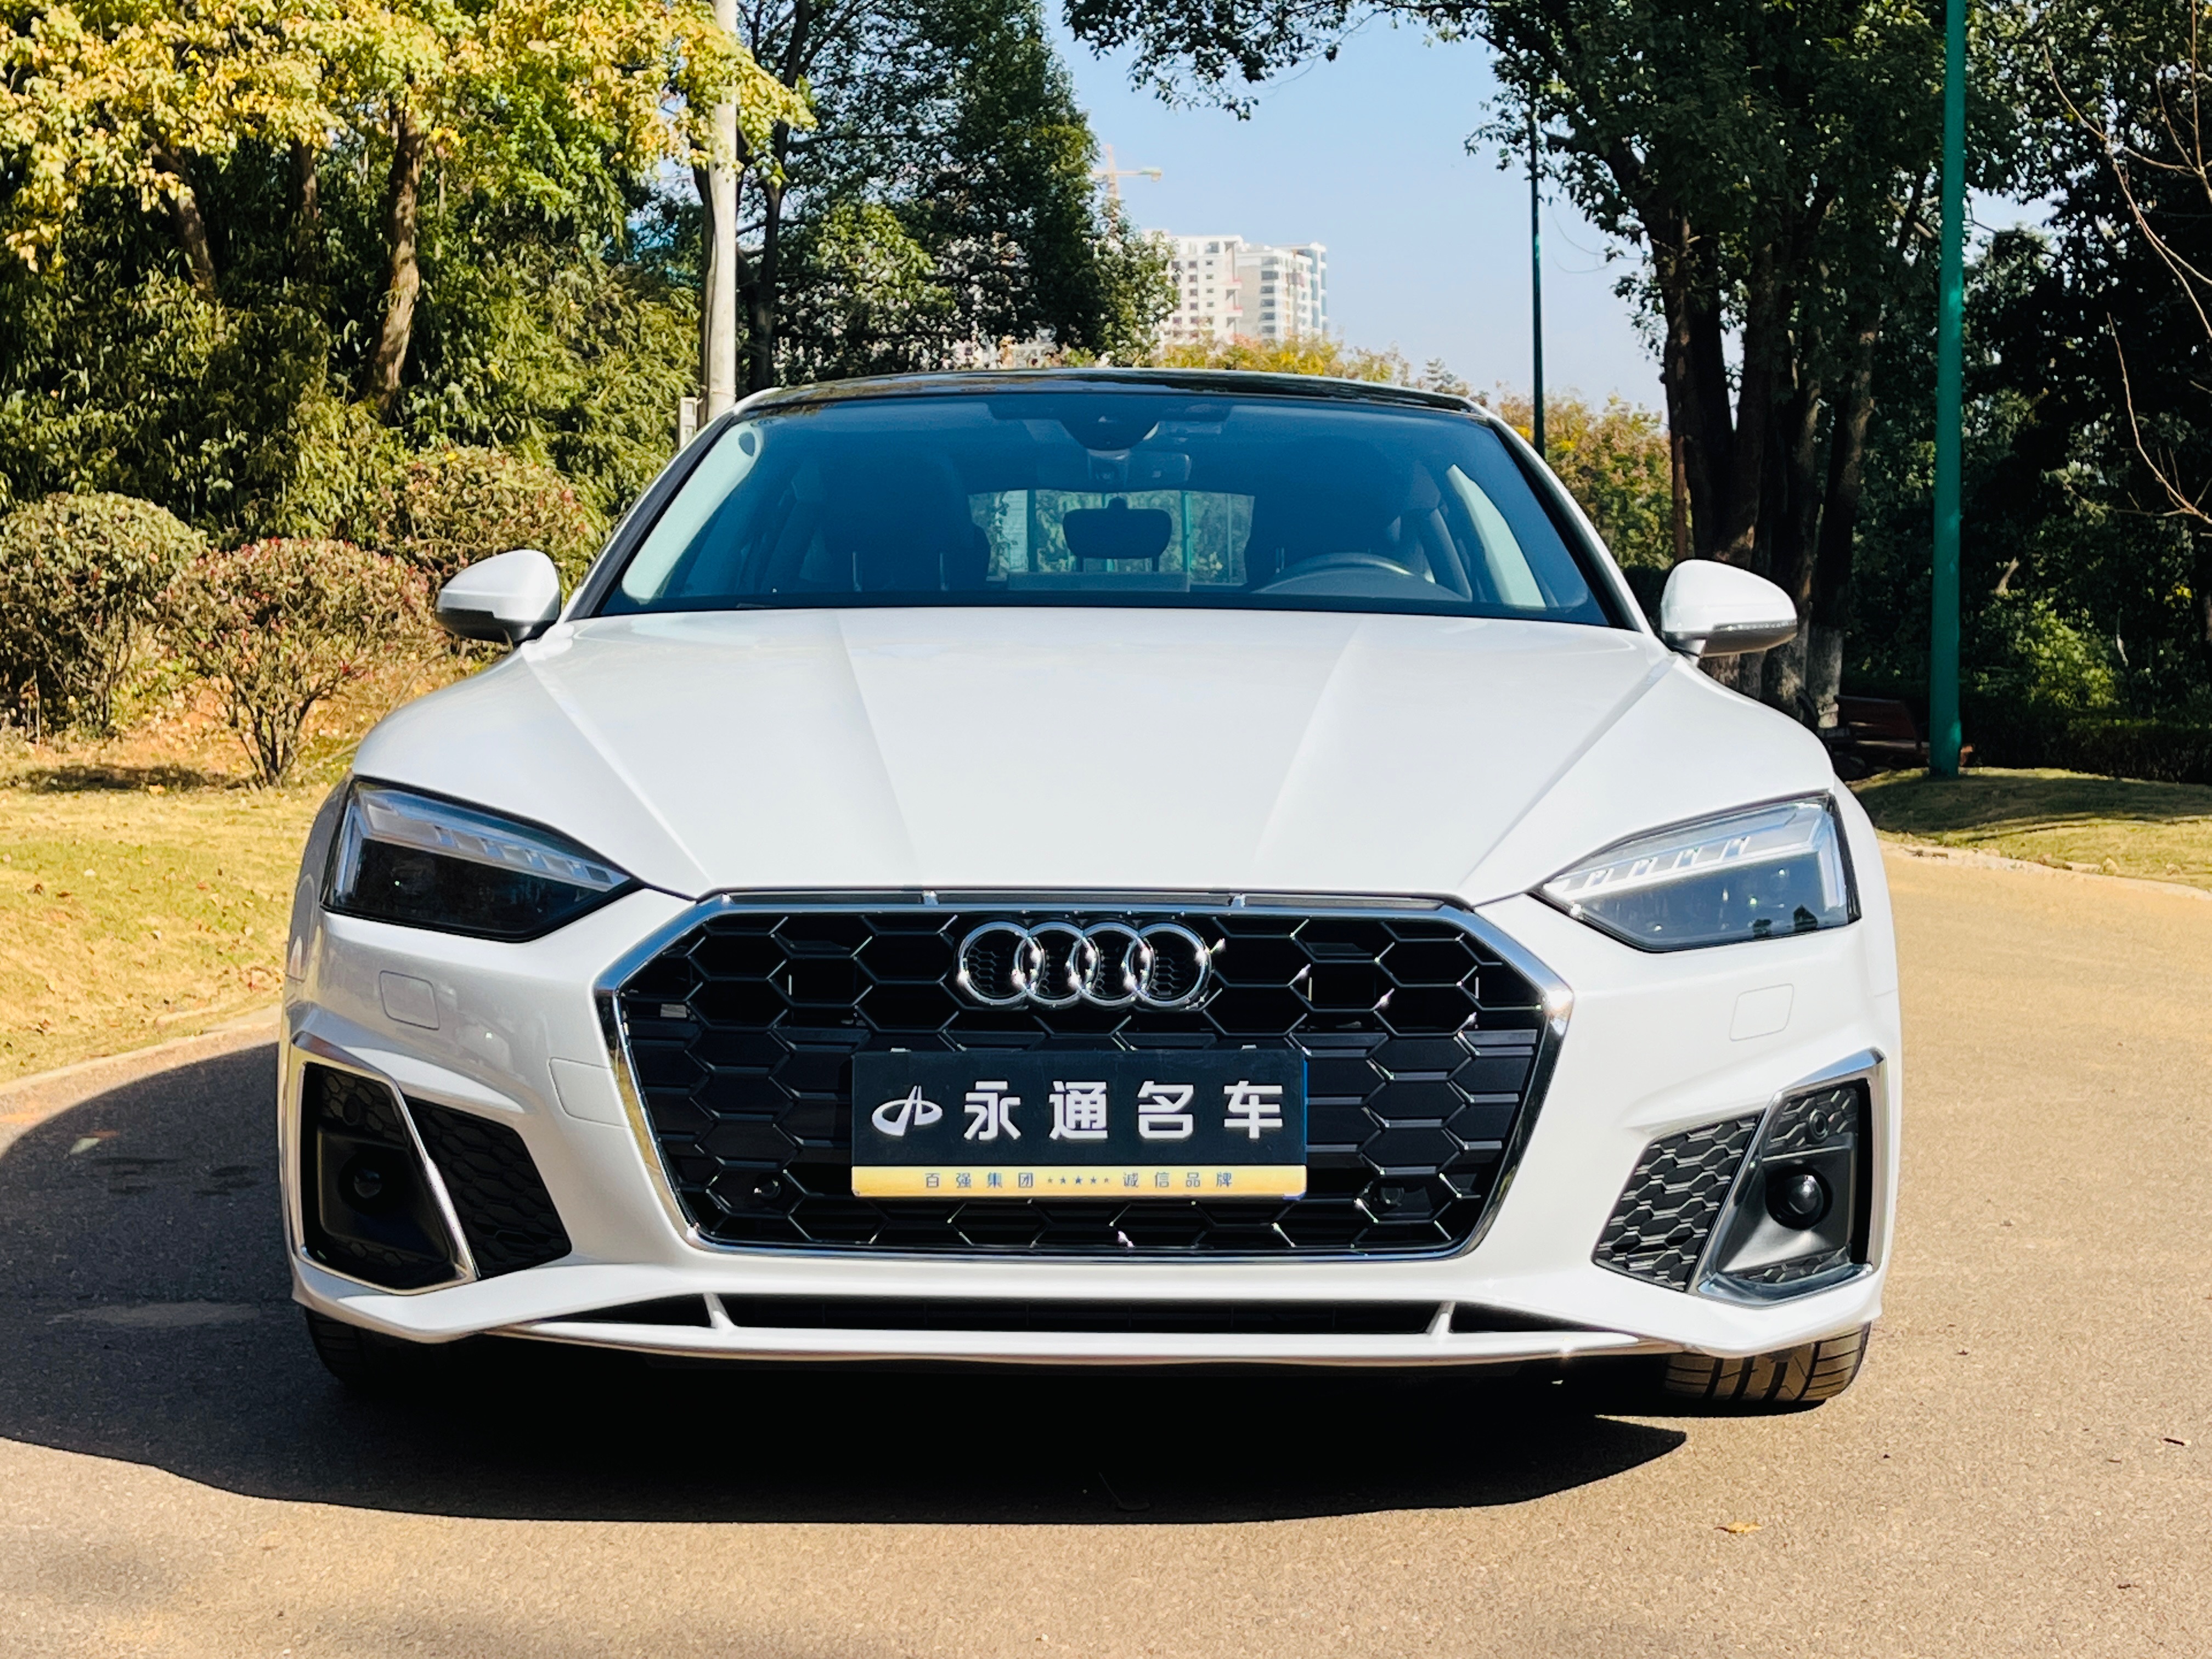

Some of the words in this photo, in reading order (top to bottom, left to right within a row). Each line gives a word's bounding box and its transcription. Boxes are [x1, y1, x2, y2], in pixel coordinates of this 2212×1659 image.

[964, 1080, 1283, 1140] 永通名车
[924, 1172, 1034, 1189] 百强集团
[1123, 1171, 1233, 1188] 诚信品牌
